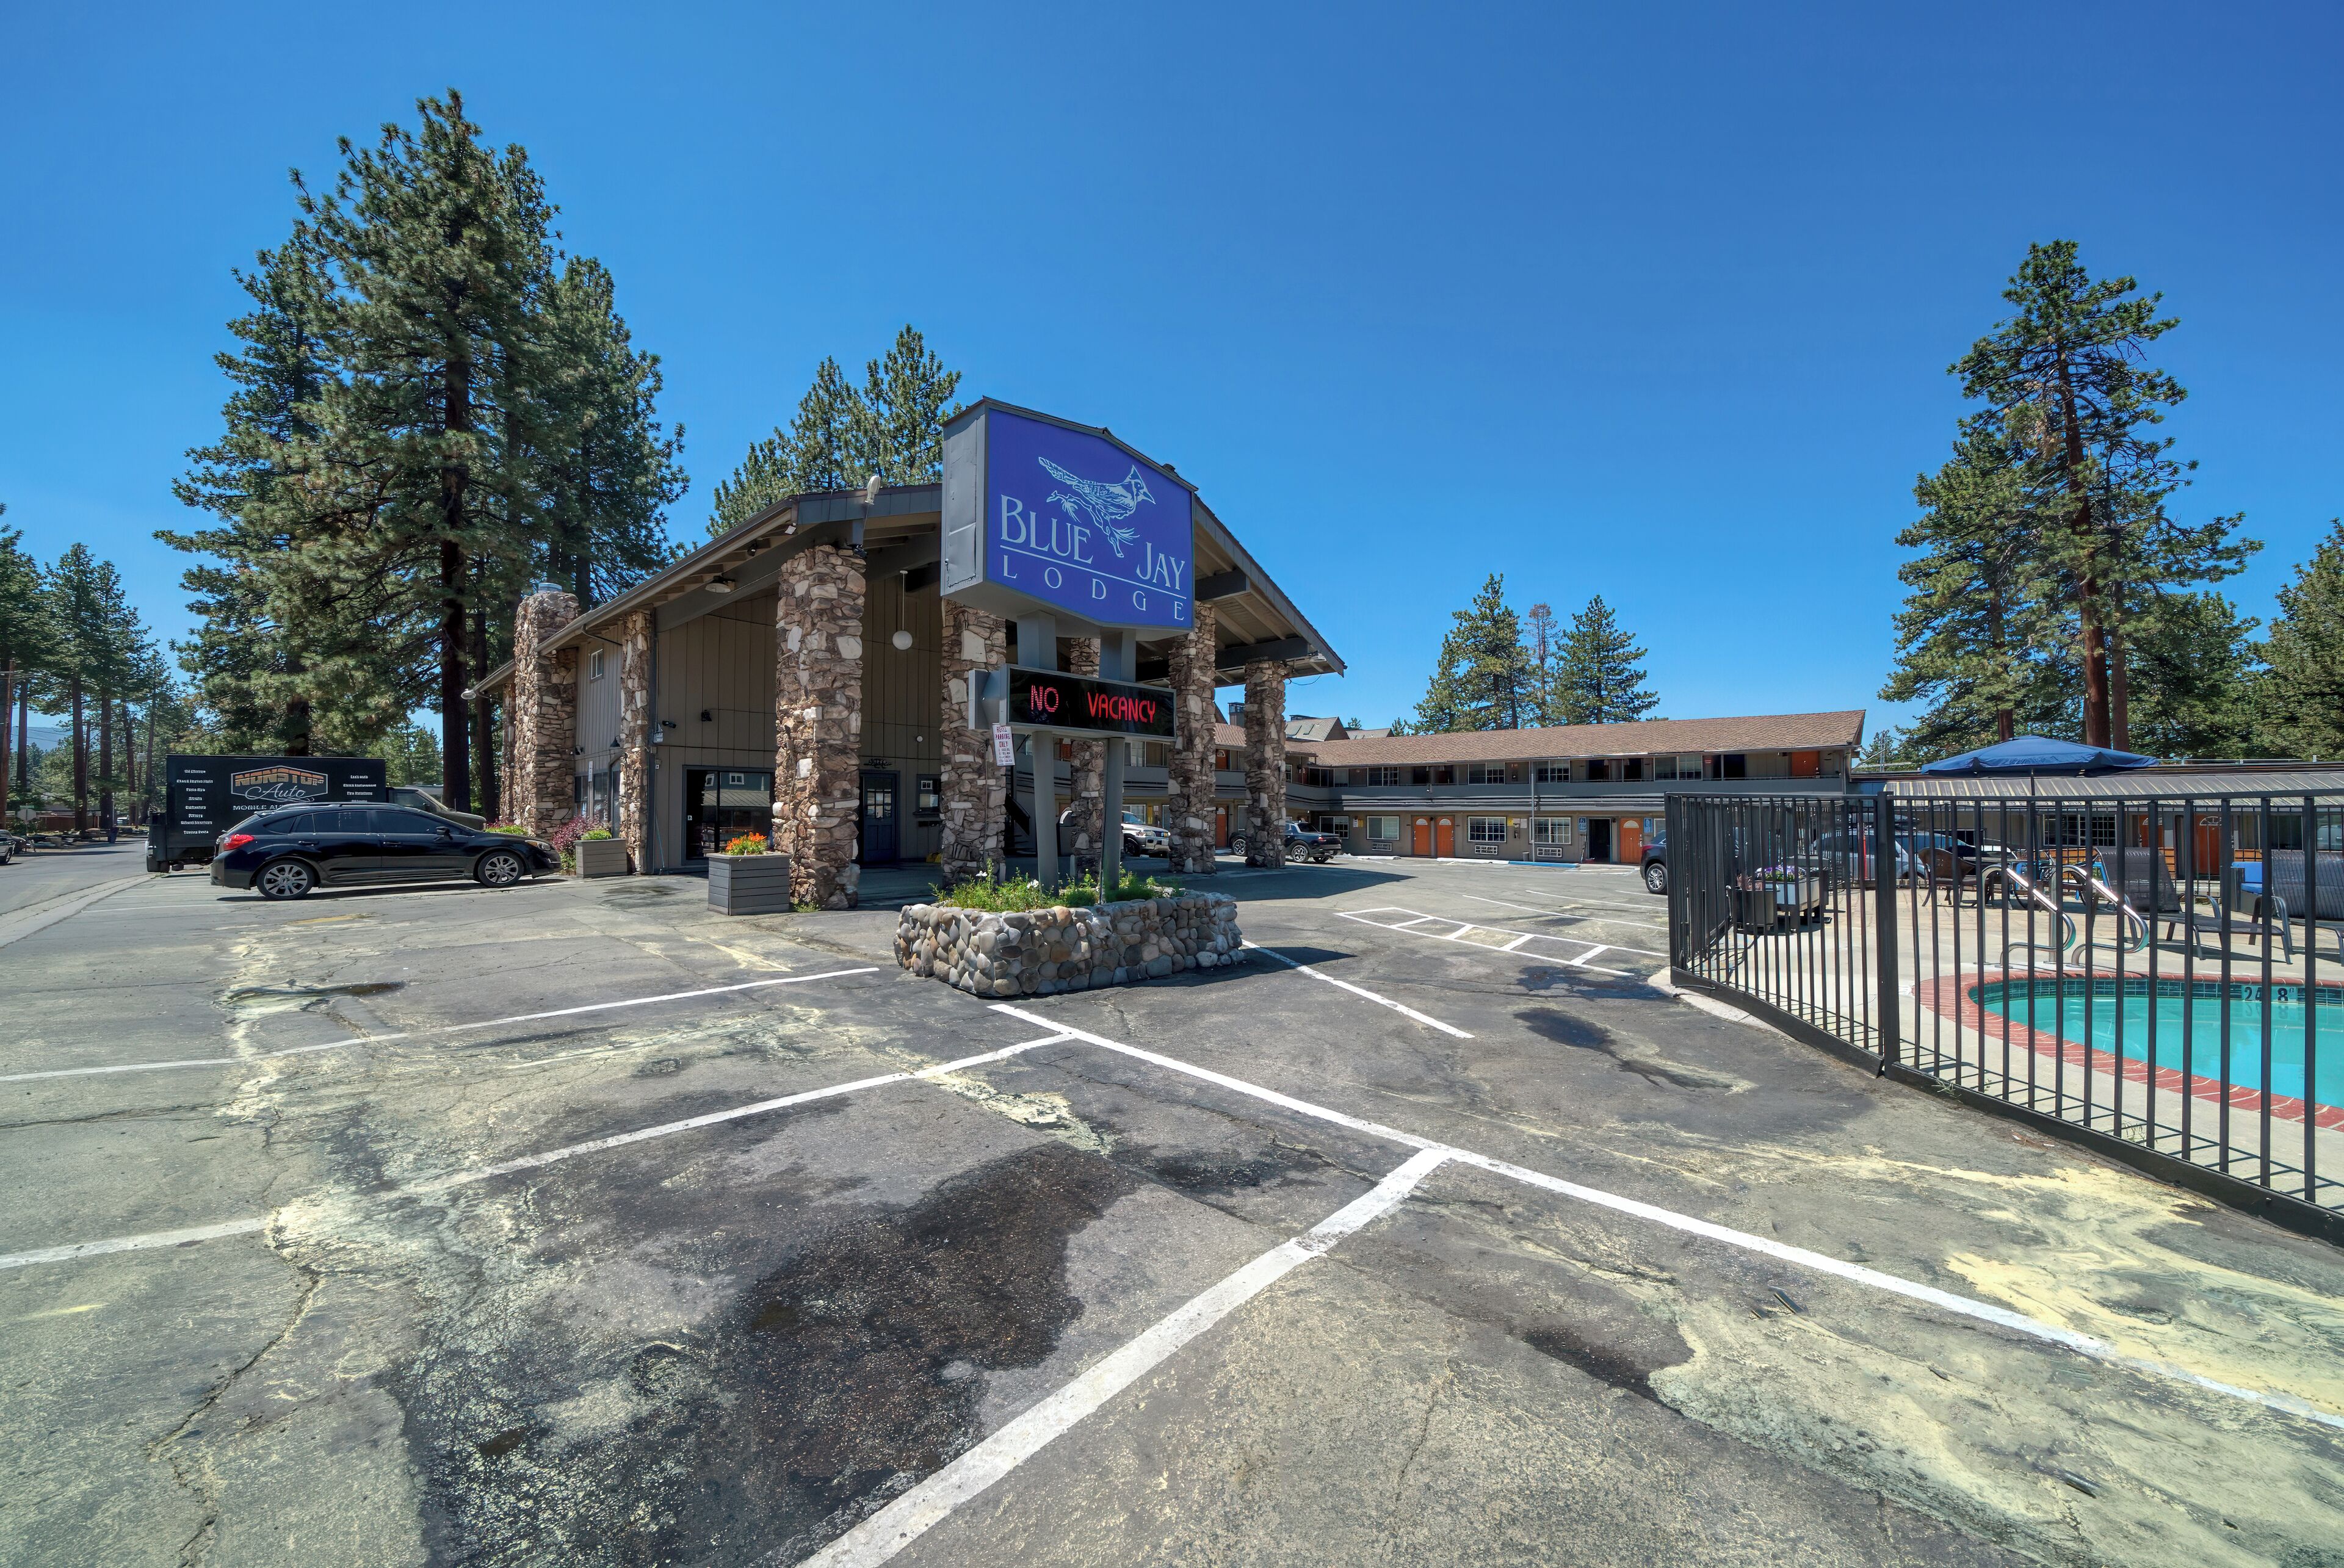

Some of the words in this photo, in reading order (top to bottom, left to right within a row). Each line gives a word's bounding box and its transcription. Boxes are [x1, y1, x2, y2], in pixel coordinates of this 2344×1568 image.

[1000, 494, 1094, 565] BLUE
[1136, 541, 1185, 591] JAY
[1003, 554, 1185, 621] LODGE
[1031, 684, 1059, 713] NO
[1087, 691, 1156, 724] VACANCY
[245, 782, 306, 800] Auto
